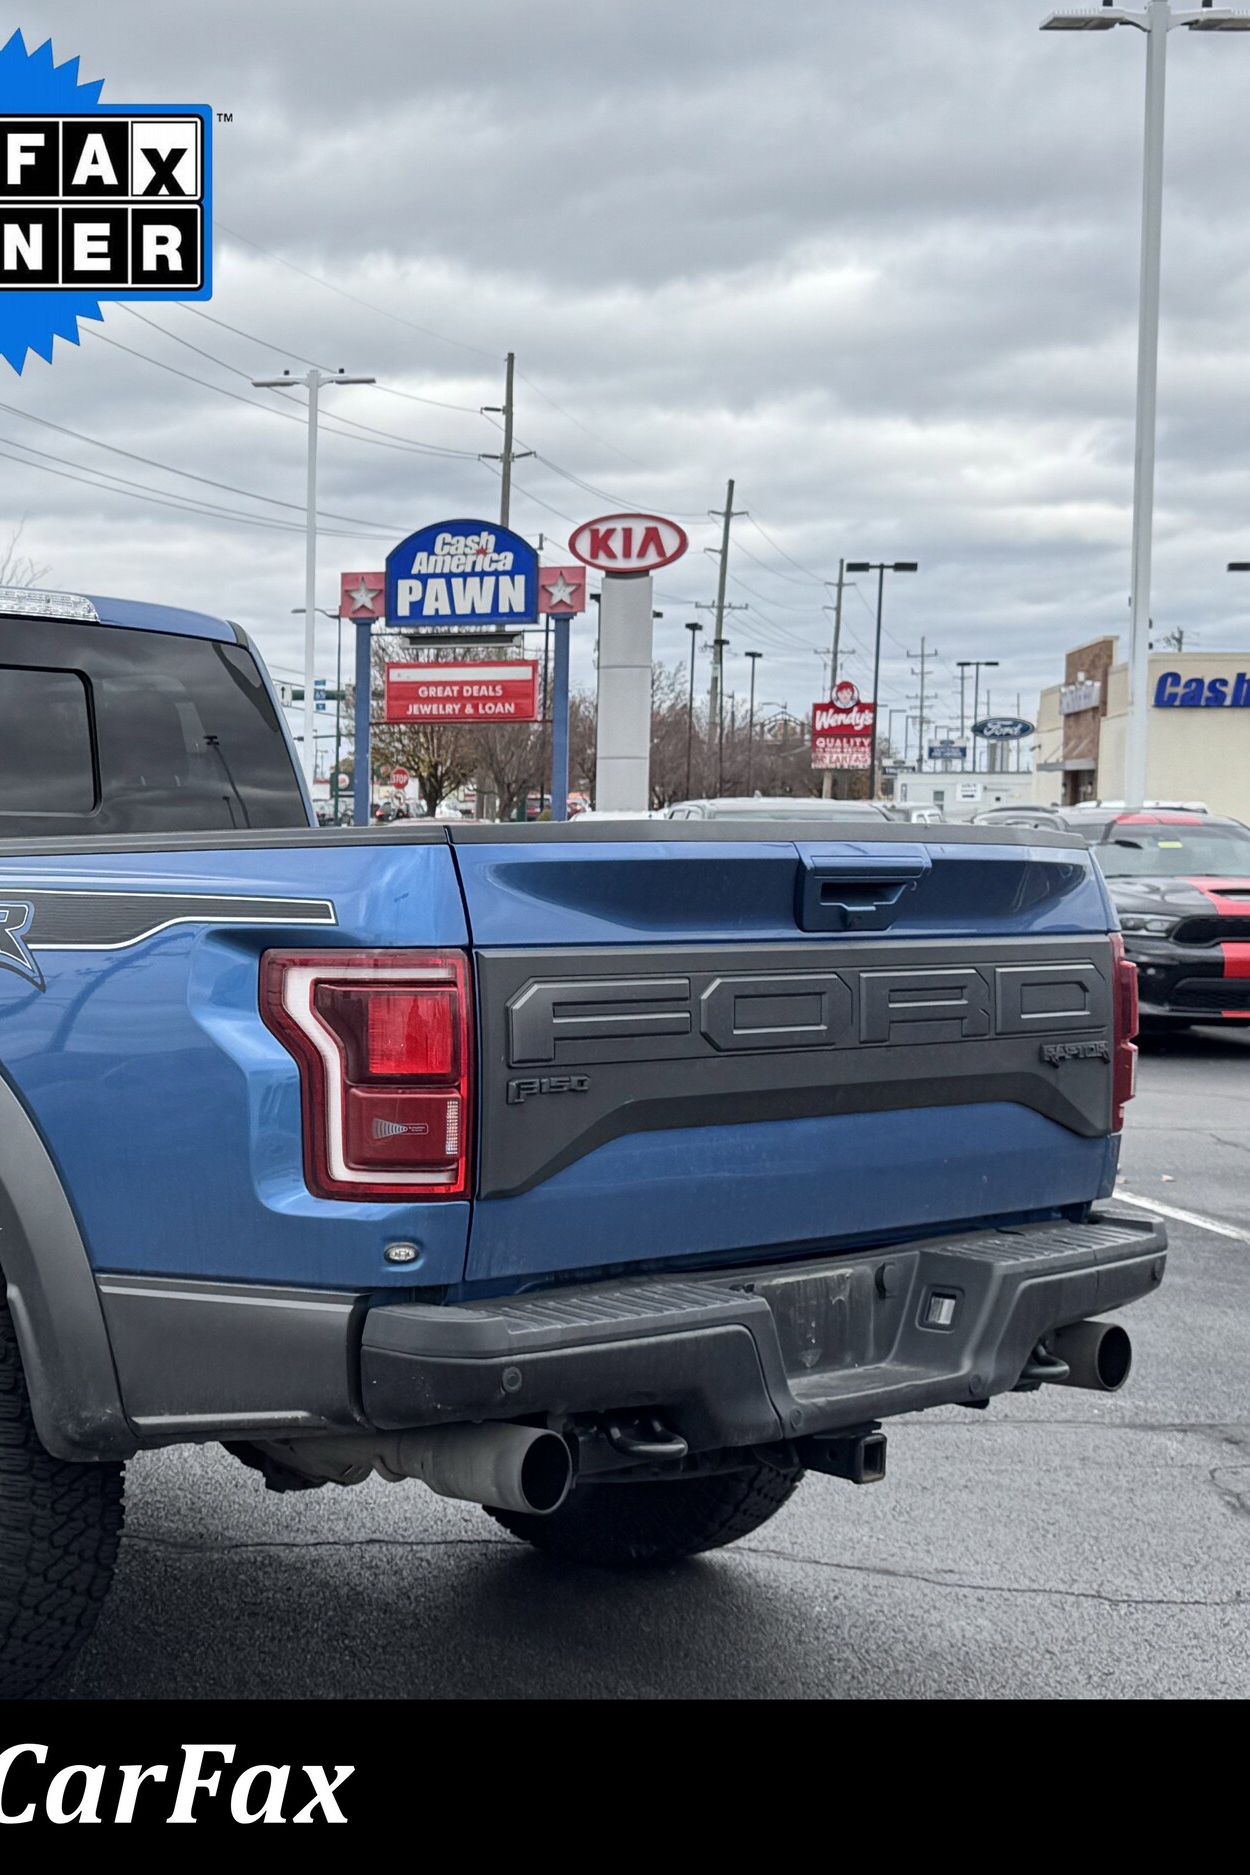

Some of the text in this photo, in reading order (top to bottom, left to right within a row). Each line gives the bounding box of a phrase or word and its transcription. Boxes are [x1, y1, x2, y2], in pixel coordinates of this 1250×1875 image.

[434, 531, 496, 555] Cash
[588, 526, 667, 560] KIA
[411, 551, 514, 575] America
[397, 574, 526, 617] PAWN
[418, 685, 503, 698] GREAT DEALS
[1153, 671, 1250, 708] Cash
[406, 702, 515, 715] JEWELRY & LOAN
[815, 706, 874, 731] Wendy's
[983, 720, 1023, 737] Ford
[816, 737, 871, 748] QUALITY
[392, 773, 408, 784] STOP
[506, 960, 1106, 1067] FORD
[1041, 1041, 1109, 1067] RAPTOR
